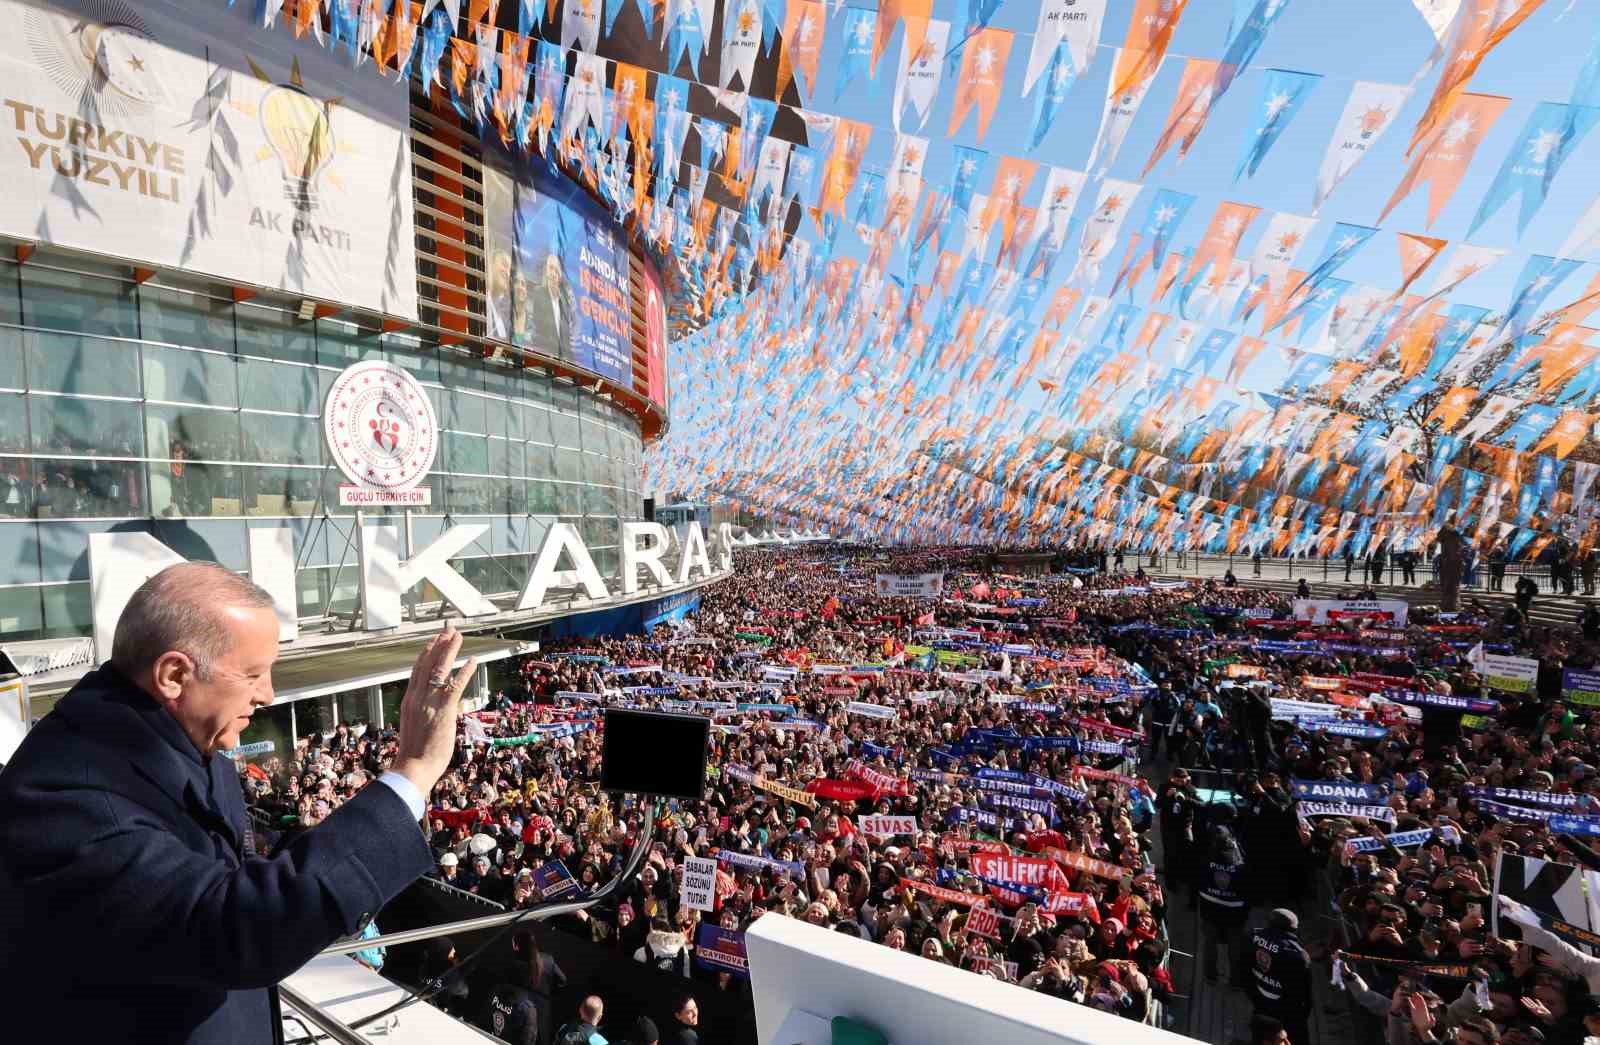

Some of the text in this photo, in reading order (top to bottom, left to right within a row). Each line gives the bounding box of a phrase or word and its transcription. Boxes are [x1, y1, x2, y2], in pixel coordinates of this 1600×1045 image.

[1048, 12, 1060, 20] AK
[17, 137, 179, 202] YÜZYILI
[249, 206, 283, 232] AK
[1019, 702, 1056, 713] SAMSUN
[1405, 690, 1468, 707] SAMSUN
[1083, 740, 1123, 754] SAMSUN
[980, 779, 1031, 795] SAMSUN
[1034, 777, 1086, 800] SAMSUN
[1311, 784, 1368, 799] ADANA
[993, 793, 1049, 813] SAMSUN
[1495, 787, 1577, 806] SAMSUN
[686, 861, 714, 875] BABALAR
[985, 855, 1047, 885] SİLİFKE
[1052, 849, 1123, 879] ALANYA
[687, 891, 707, 905] TUTAR
[967, 908, 1001, 938] ERDE
